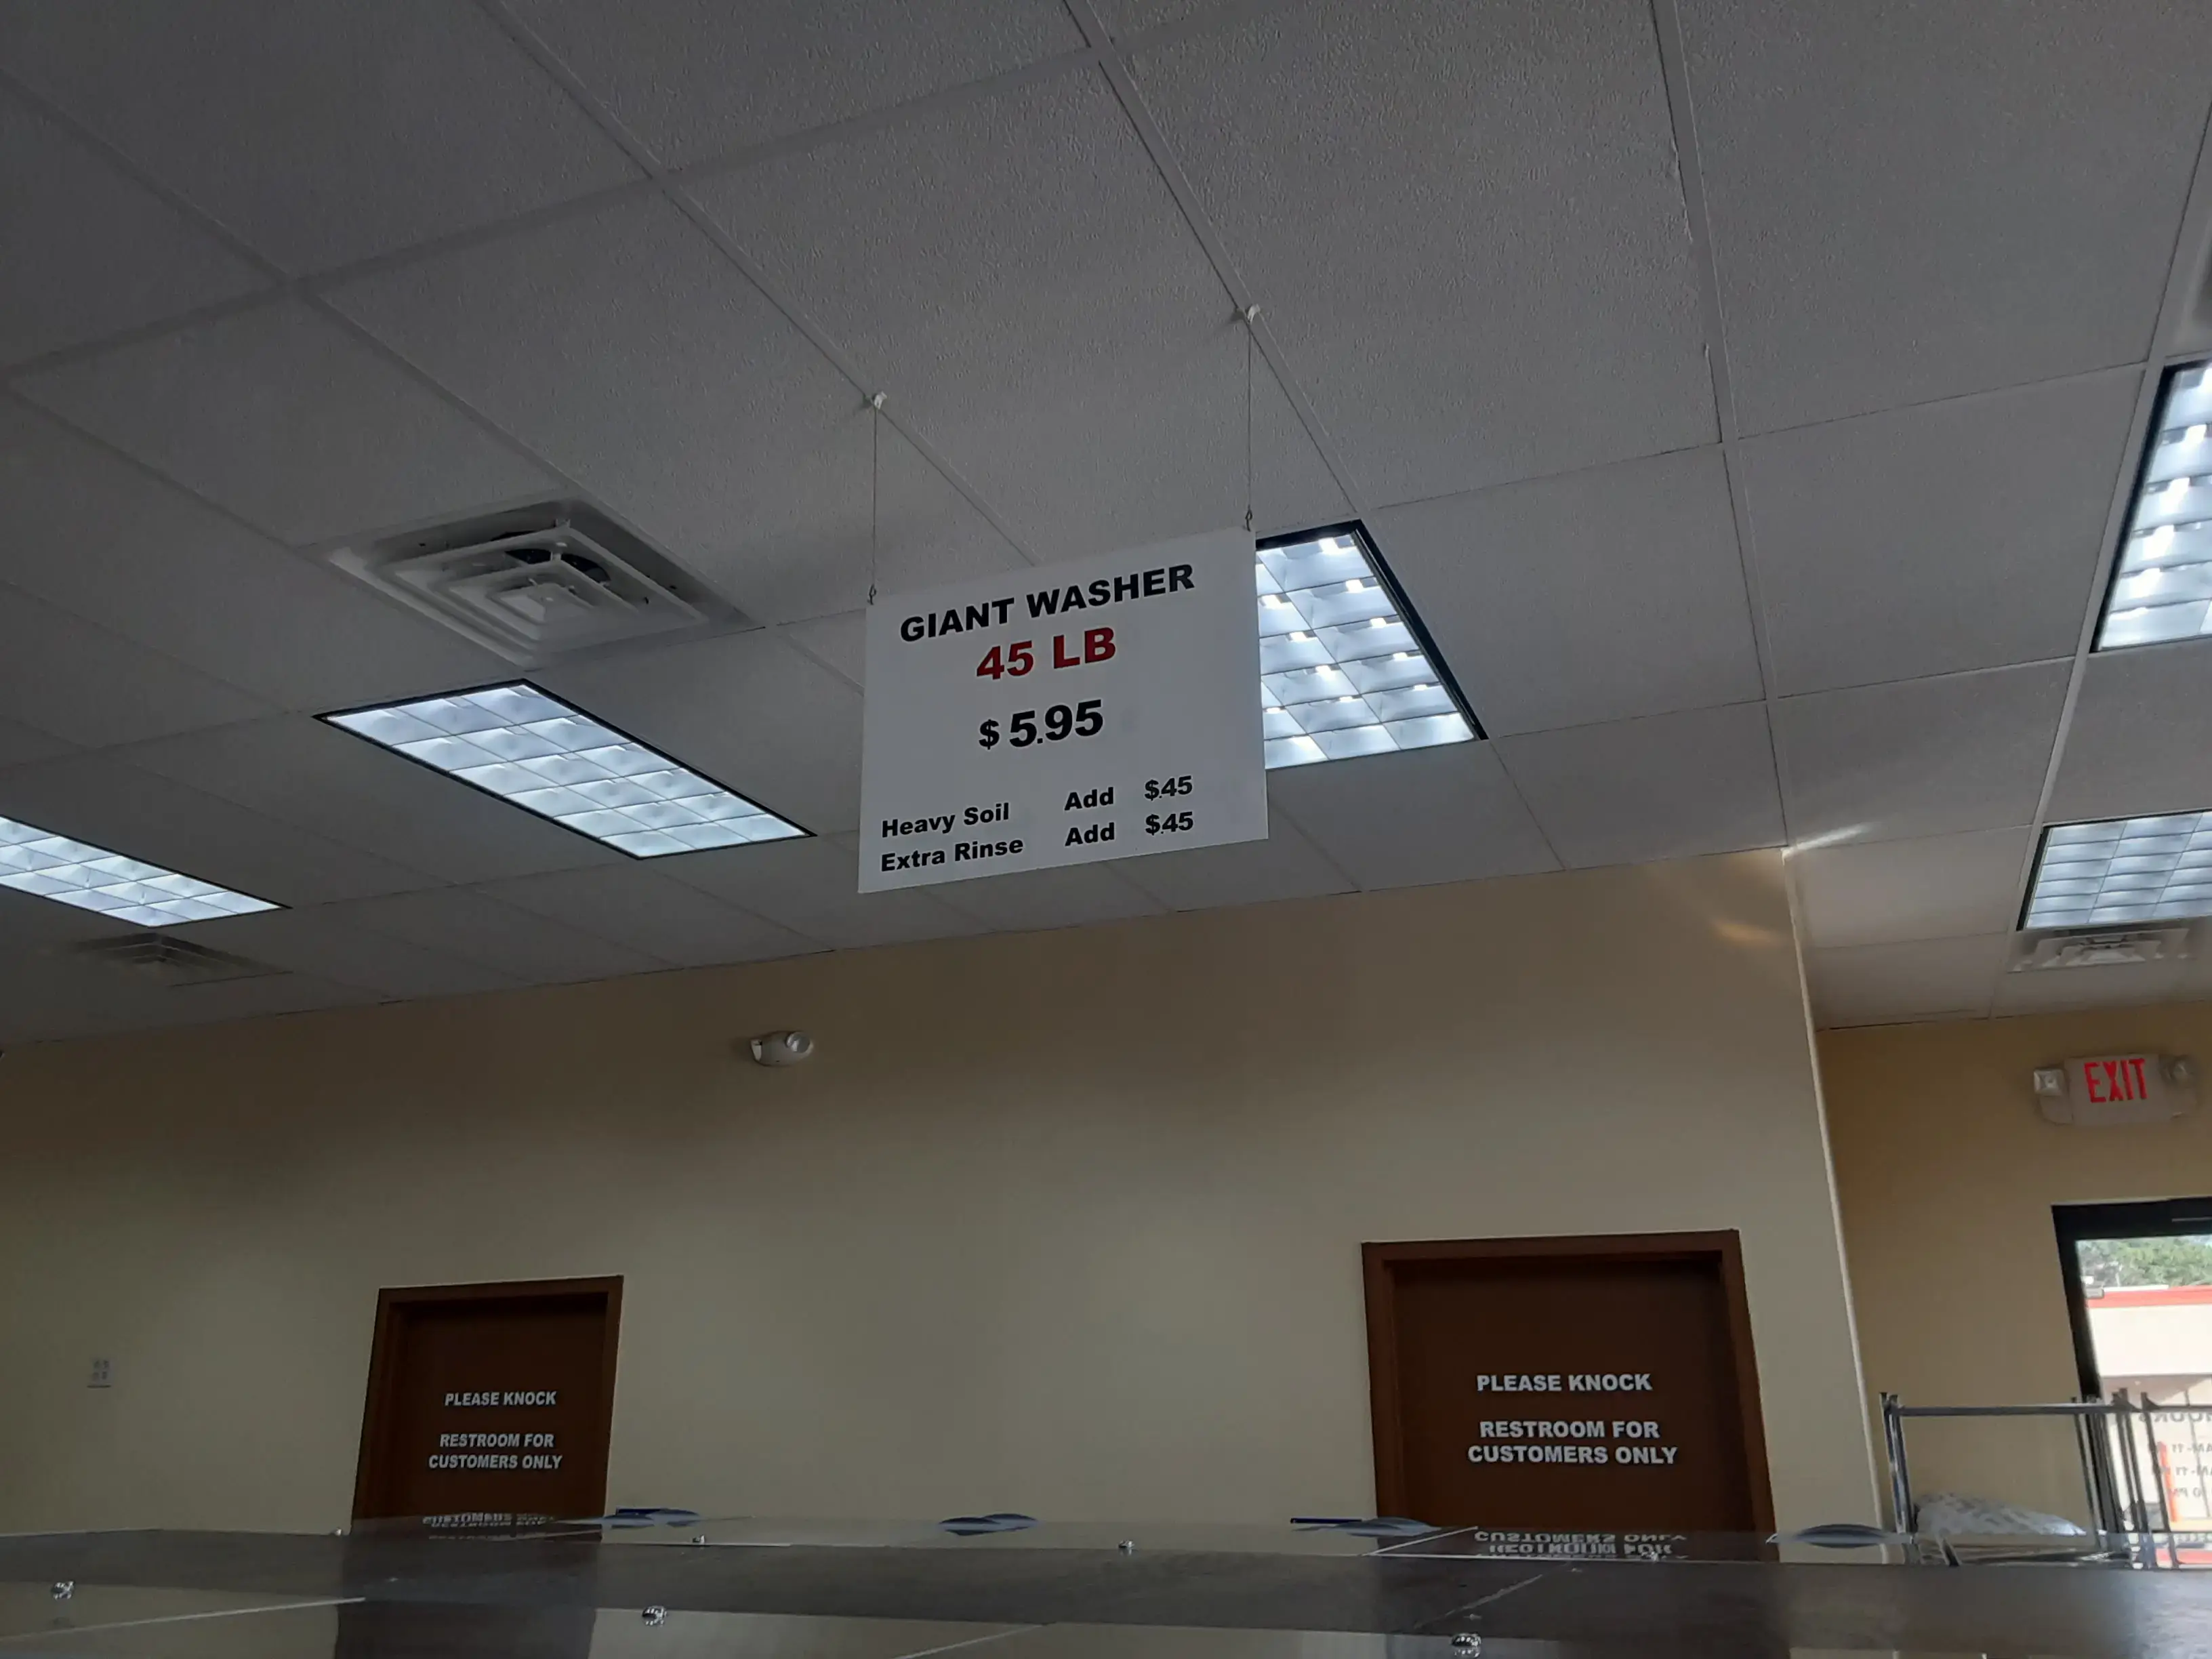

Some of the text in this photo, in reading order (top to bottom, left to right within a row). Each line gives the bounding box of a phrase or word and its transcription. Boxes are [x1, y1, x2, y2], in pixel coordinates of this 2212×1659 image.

[901, 564, 1195, 642] GIANT WASHER
[977, 627, 1116, 680] 45 LB
[1009, 699, 1103, 748] 5.95
[882, 815, 956, 838] Heavy
[964, 802, 1010, 825] Soil
[1064, 786, 1114, 811] Add
[881, 842, 945, 873] Extra
[954, 840, 1023, 861] Rinse
[1065, 822, 1115, 846] Add
[2082, 1057, 2149, 1105] EXIT
[445, 1391, 557, 1406] PLEASE KNOCK
[1477, 1374, 1652, 1391] PLEASE KNOCK
[440, 1433, 555, 1448] RESTROOM FOR
[1479, 1420, 1660, 1438] RESTROOM FOR
[429, 1454, 563, 1469] CUSTOMERS ONLY
[1468, 1446, 1678, 1464] CUSTOMERS ONLY
